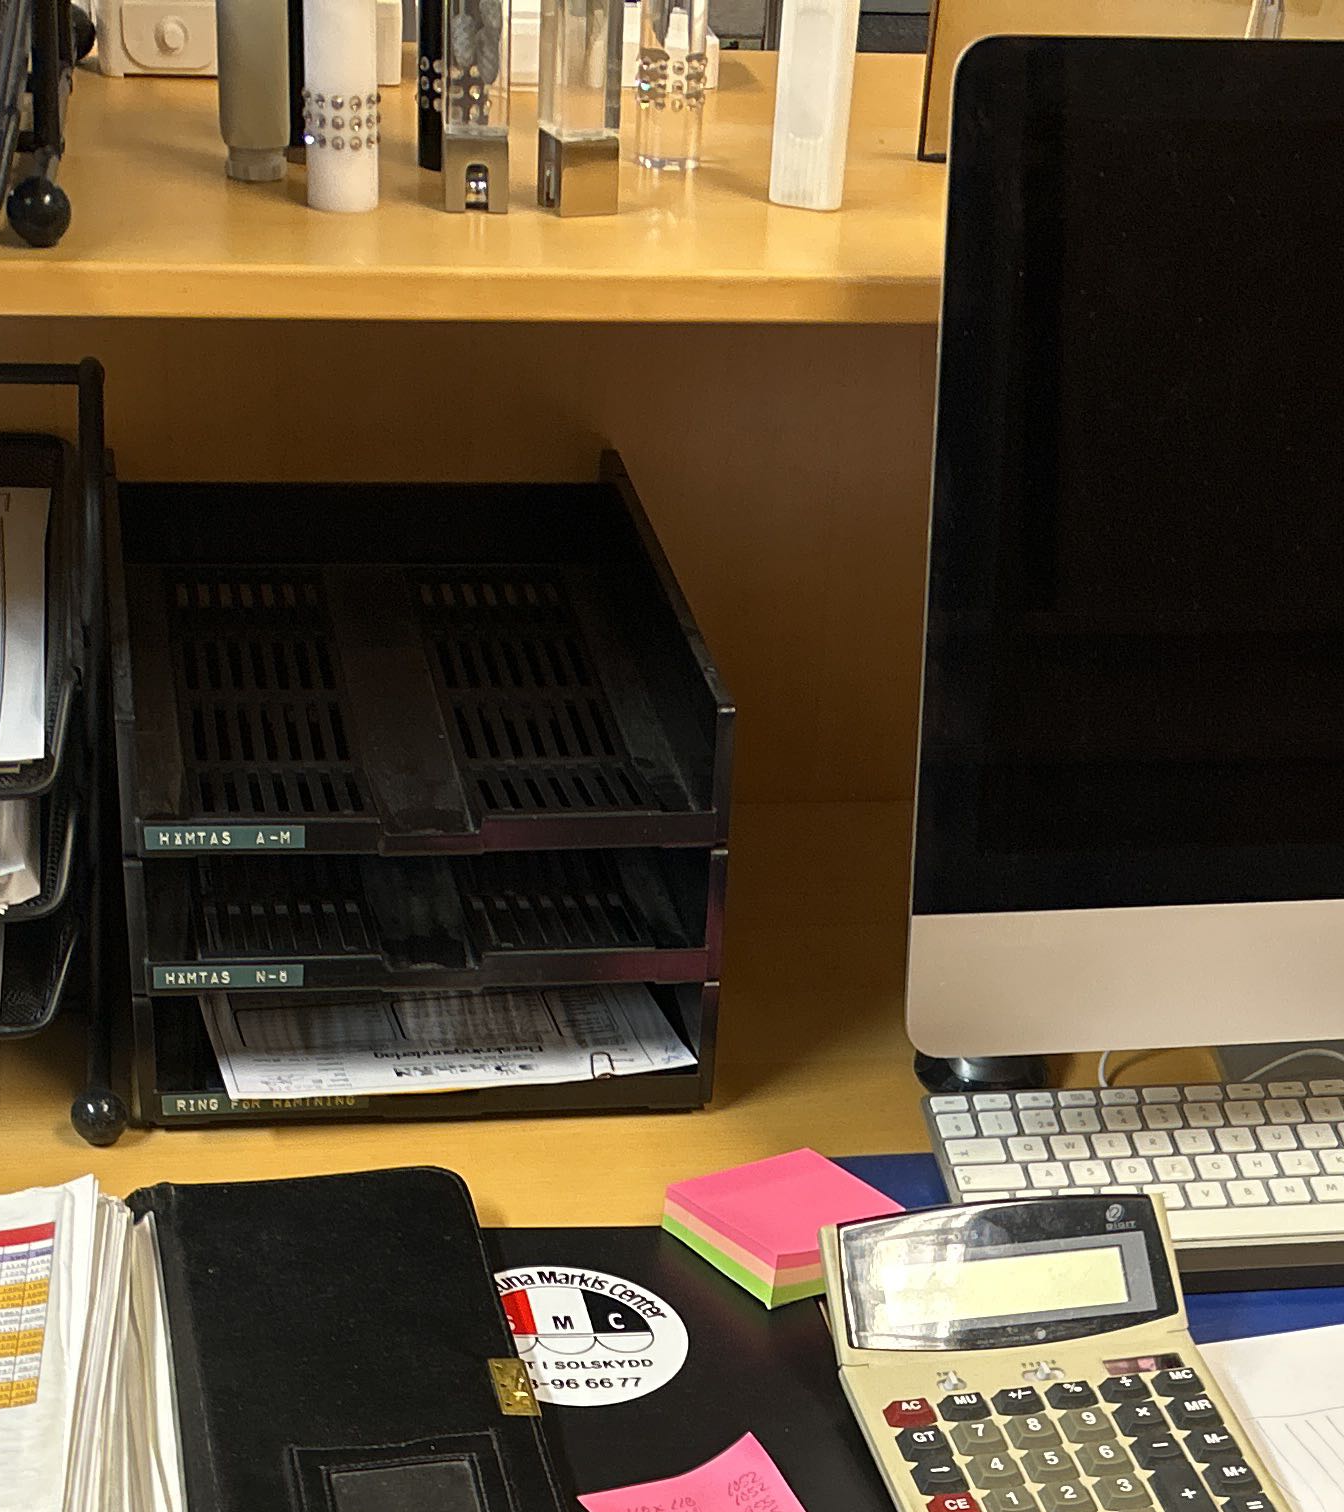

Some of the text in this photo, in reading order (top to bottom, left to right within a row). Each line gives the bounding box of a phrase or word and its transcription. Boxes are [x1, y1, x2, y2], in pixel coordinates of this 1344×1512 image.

[256, 831, 291, 845] A-M
[176, 1098, 218, 1112] RING
[537, 1271, 609, 1289] Markis
[609, 1283, 668, 1320] Center
[552, 1312, 626, 1330] M C
[554, 1359, 654, 1370] SOLSKYDD
[1169, 1369, 1193, 1380] MC
[585, 1378, 614, 1389] 66
[620, 1377, 642, 1388] 77
[1062, 1383, 1083, 1393] %
[901, 1401, 922, 1411] AC
[954, 1395, 977, 1405] MU
[1184, 1400, 1212, 1412] MR
[1027, 1418, 1042, 1431] 8
[1081, 1411, 1097, 1425] 9
[912, 1430, 935, 1443] GT
[971, 1423, 985, 1437] 7
[1043, 1452, 1059, 1465] 5
[1098, 1445, 1114, 1459] 6
[990, 1457, 1004, 1471] 4
[1222, 1466, 1248, 1478] M+
[1116, 1478, 1132, 1492] 3
[1006, 1492, 1019, 1505] 1
[1060, 1486, 1077, 1499] 2
[944, 1499, 970, 1510] CE
